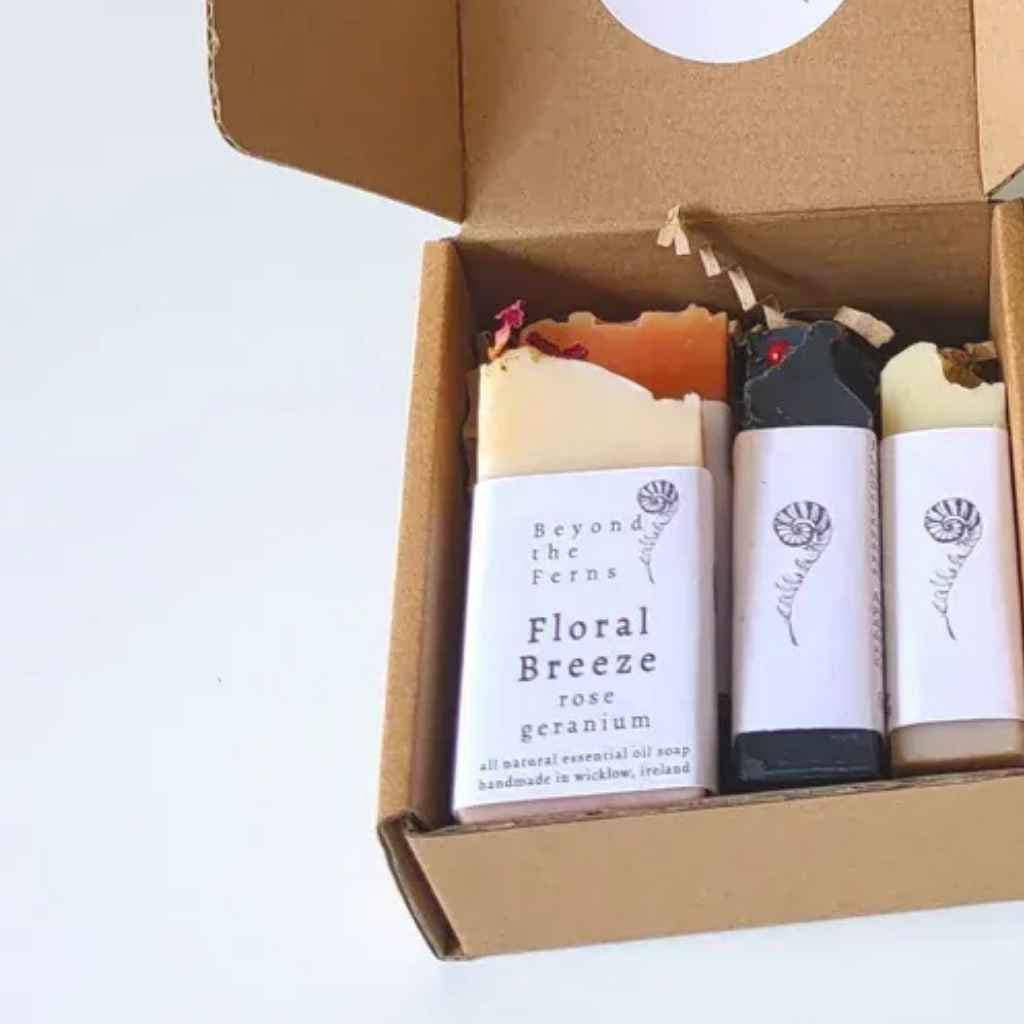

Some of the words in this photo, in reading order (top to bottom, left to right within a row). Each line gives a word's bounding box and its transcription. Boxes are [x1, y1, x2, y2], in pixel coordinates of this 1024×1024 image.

[533, 514, 642, 539] Beyond
[532, 543, 578, 561] the
[532, 567, 617, 585] Ferns
[527, 606, 649, 643] Floral
[518, 652, 656, 682] Breeze
[559, 690, 615, 708] rose
[520, 712, 651, 743] geranium
[479, 758, 498, 771] all
[503, 753, 557, 769] natural
[562, 748, 628, 764] essential
[632, 745, 651, 759] oil
[657, 745, 691, 760] soap
[478, 774, 551, 791] handmade
[555, 773, 570, 784] in
[640, 762, 691, 777] ireland
